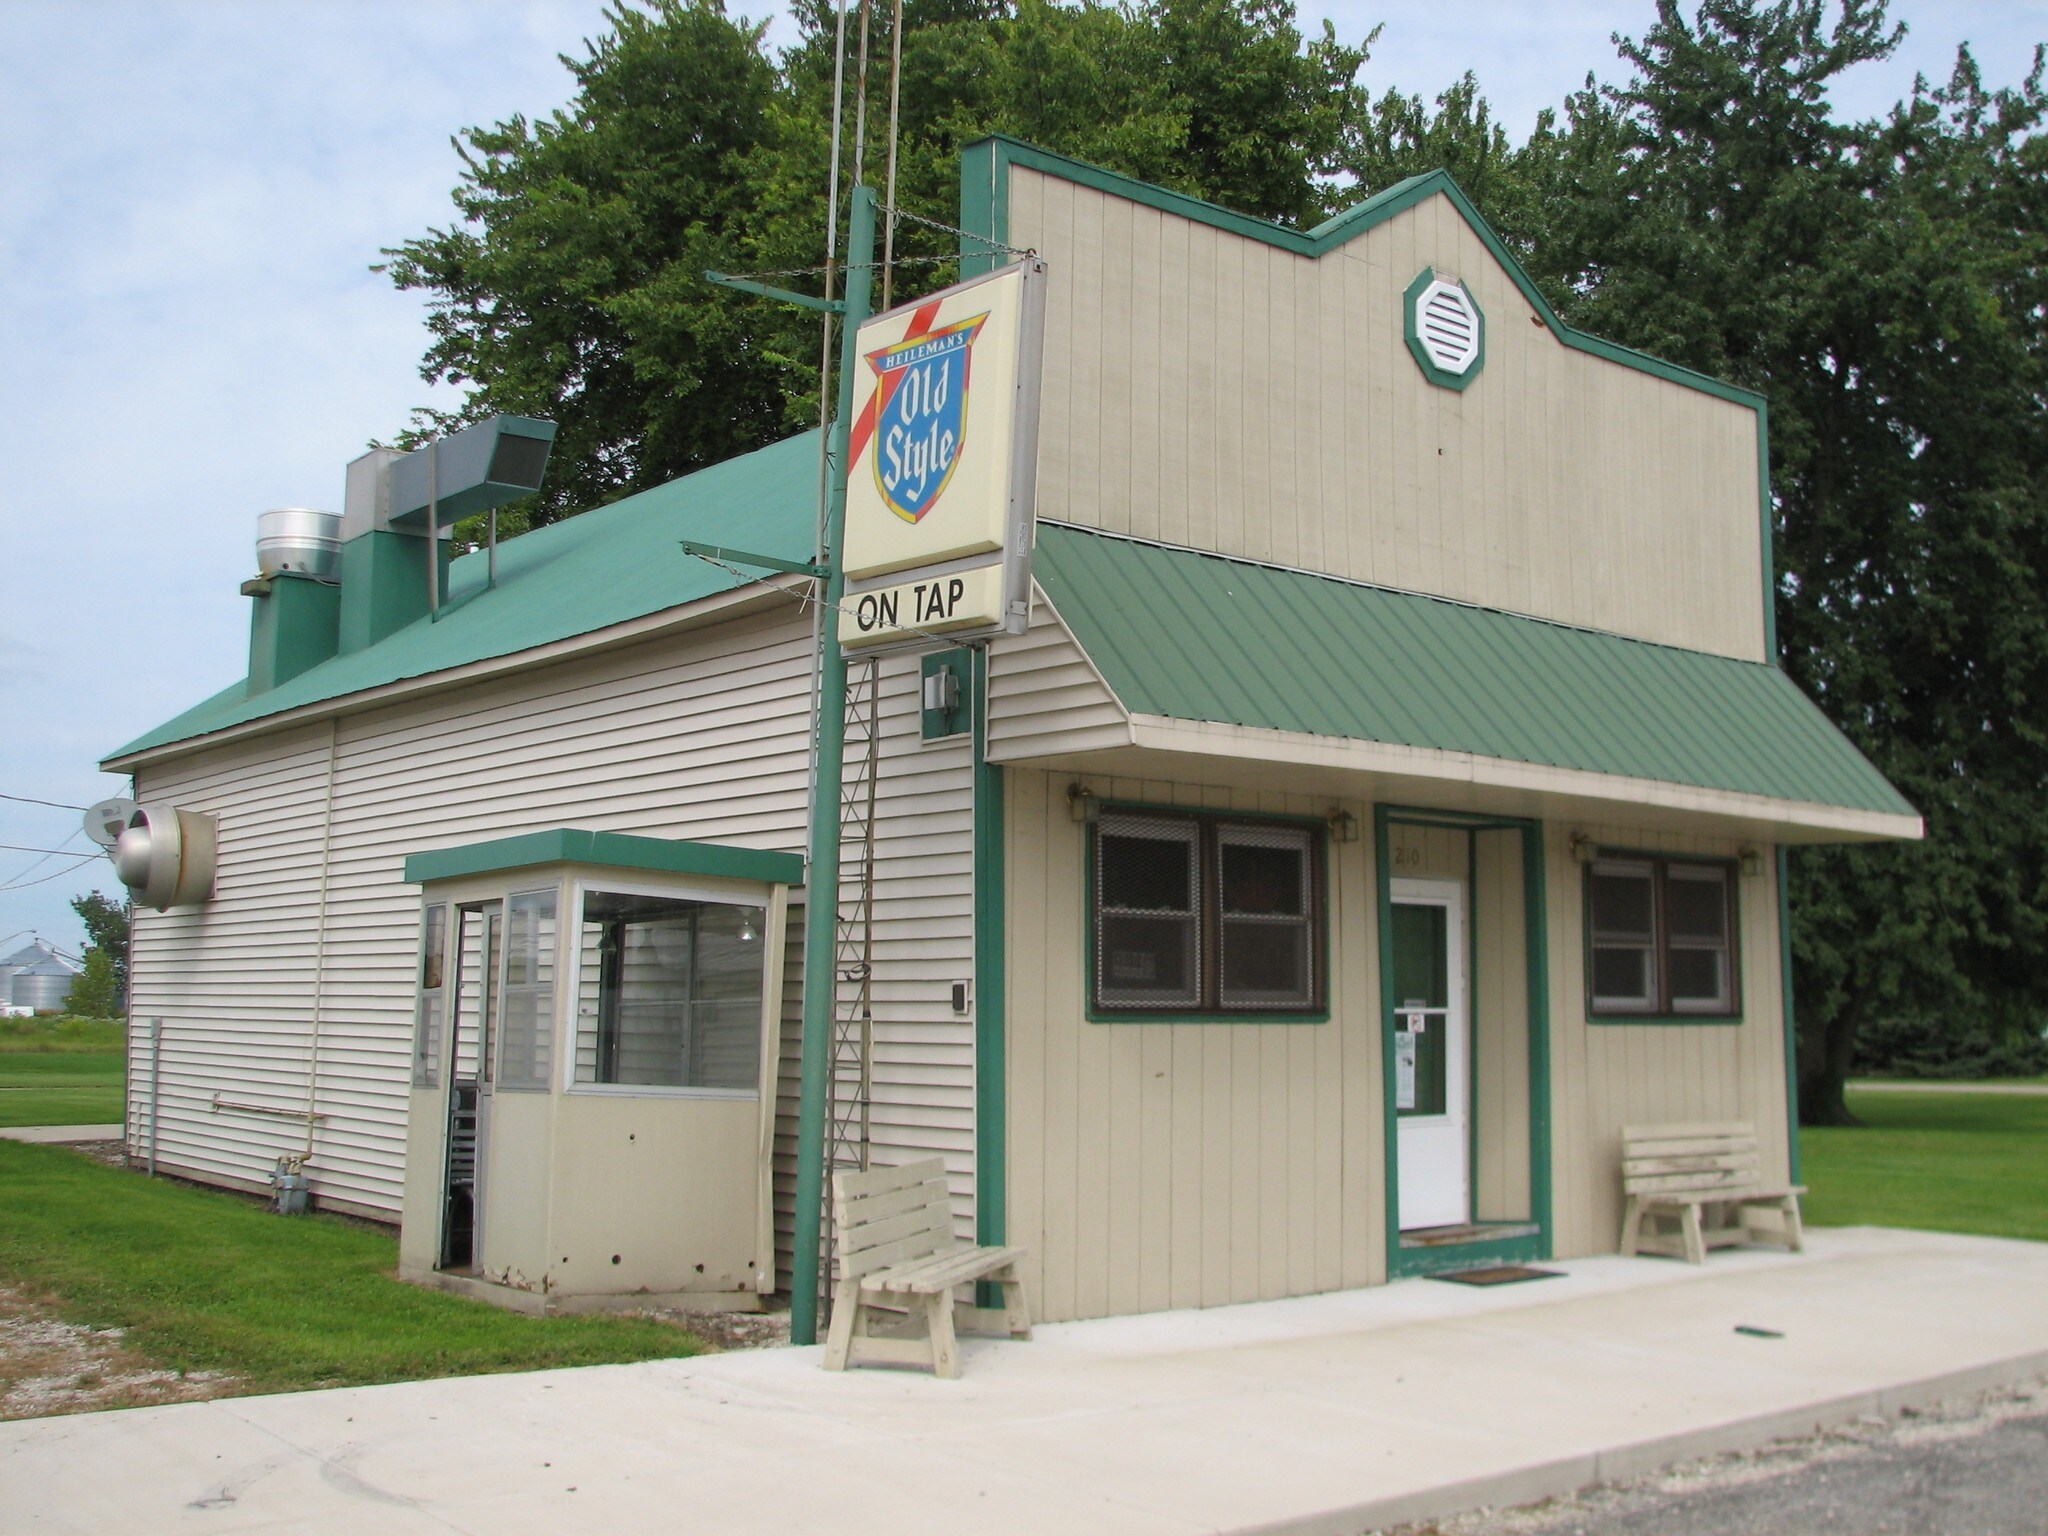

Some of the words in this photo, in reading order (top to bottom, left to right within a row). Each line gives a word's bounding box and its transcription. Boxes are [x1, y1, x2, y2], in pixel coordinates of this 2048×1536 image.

[885, 332, 964, 368] HEILEMAN'S
[901, 357, 949, 426] Old
[883, 418, 954, 503] Style
[857, 590, 899, 632] ON
[914, 578, 964, 622] TAP
